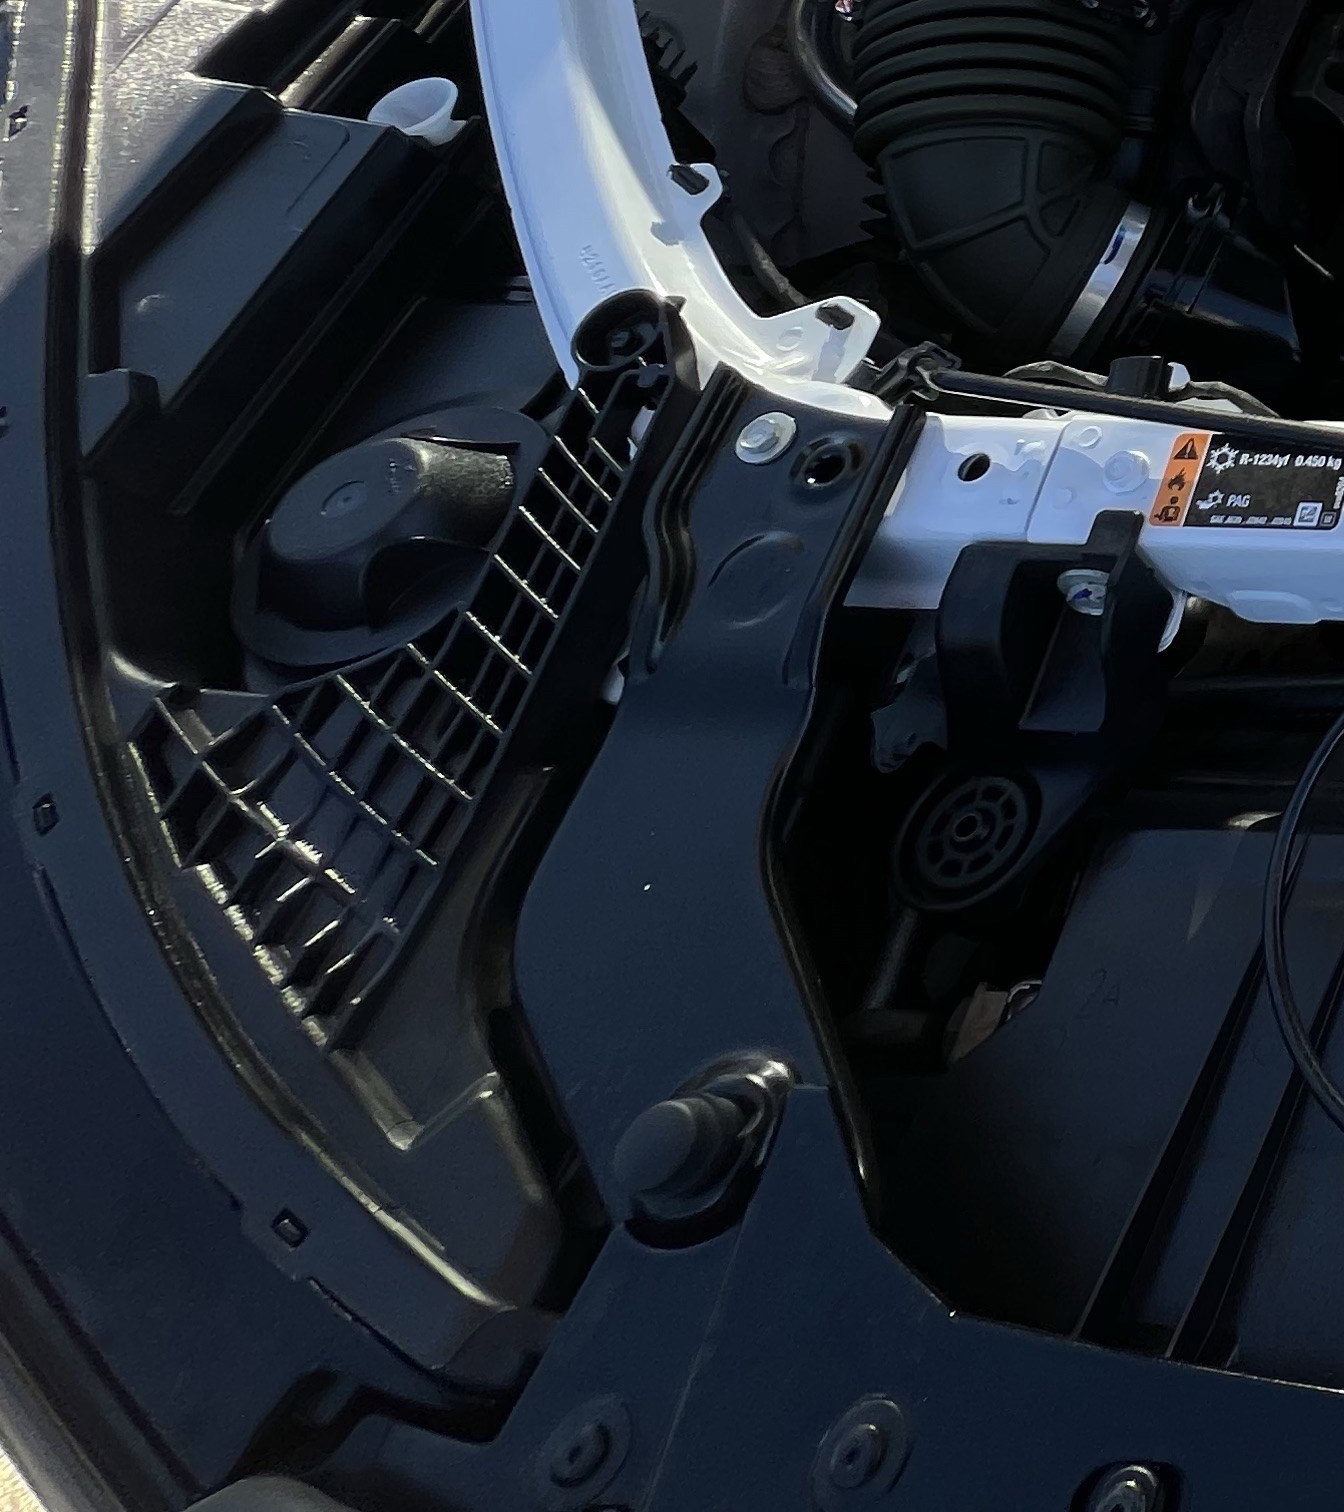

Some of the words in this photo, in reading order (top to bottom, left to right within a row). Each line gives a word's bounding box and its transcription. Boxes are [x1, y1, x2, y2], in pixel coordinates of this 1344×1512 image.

[1294, 454, 1326, 467] 0.450
[1326, 455, 1343, 471] kg
[1226, 493, 1251, 508] PAG
